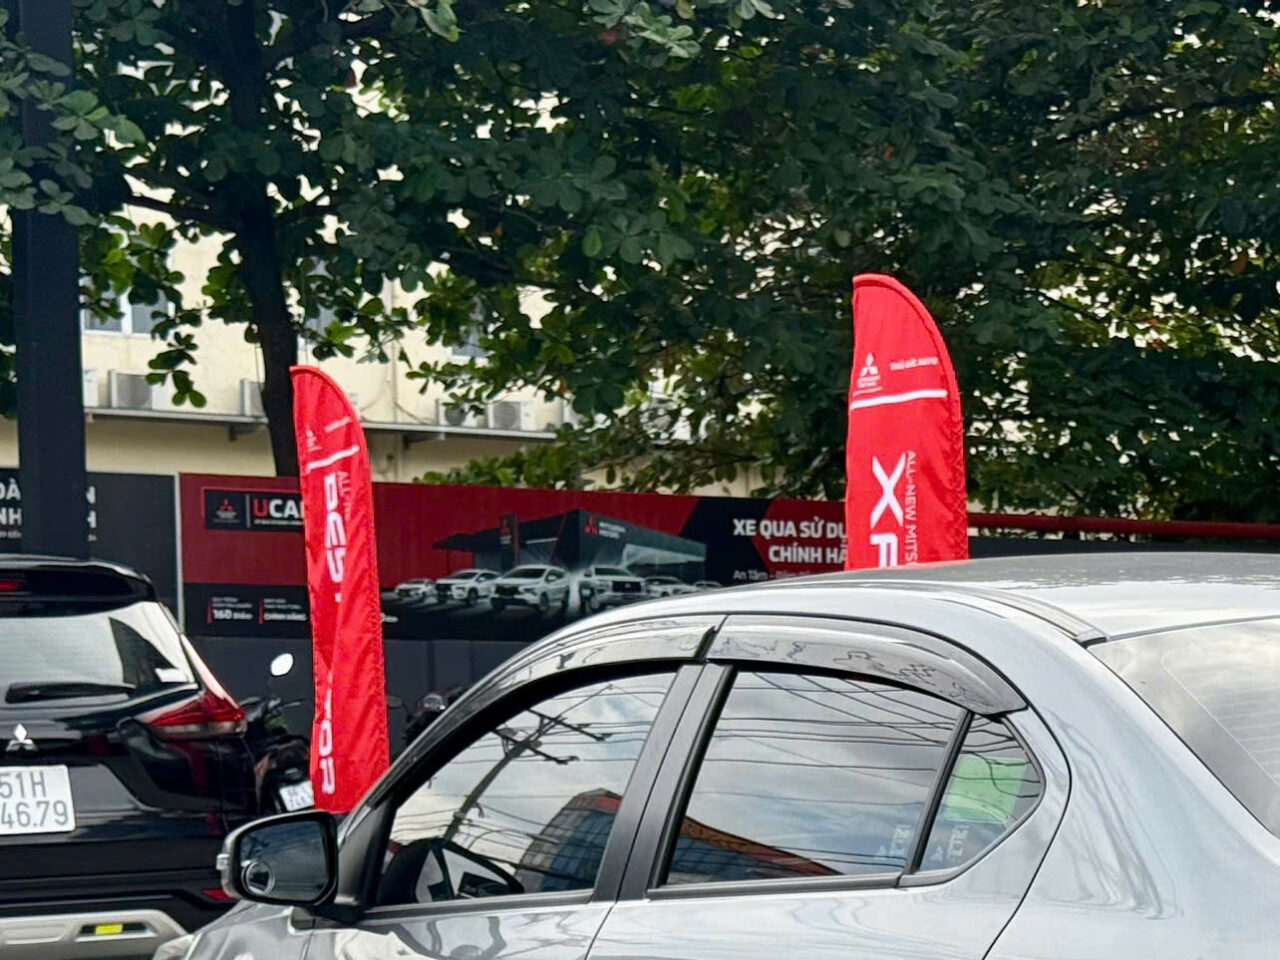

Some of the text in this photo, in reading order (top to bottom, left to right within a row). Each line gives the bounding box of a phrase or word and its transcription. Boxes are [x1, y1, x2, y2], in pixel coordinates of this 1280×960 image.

[904, 450, 917, 521] ALL-NEW
[253, 499, 305, 520] UCA
[733, 518, 757, 536] XE
[759, 520, 798, 541] QUA
[799, 516, 825, 539] SỬ
[768, 541, 824, 564] CHÍNH
[0, 770, 47, 798] 51H
